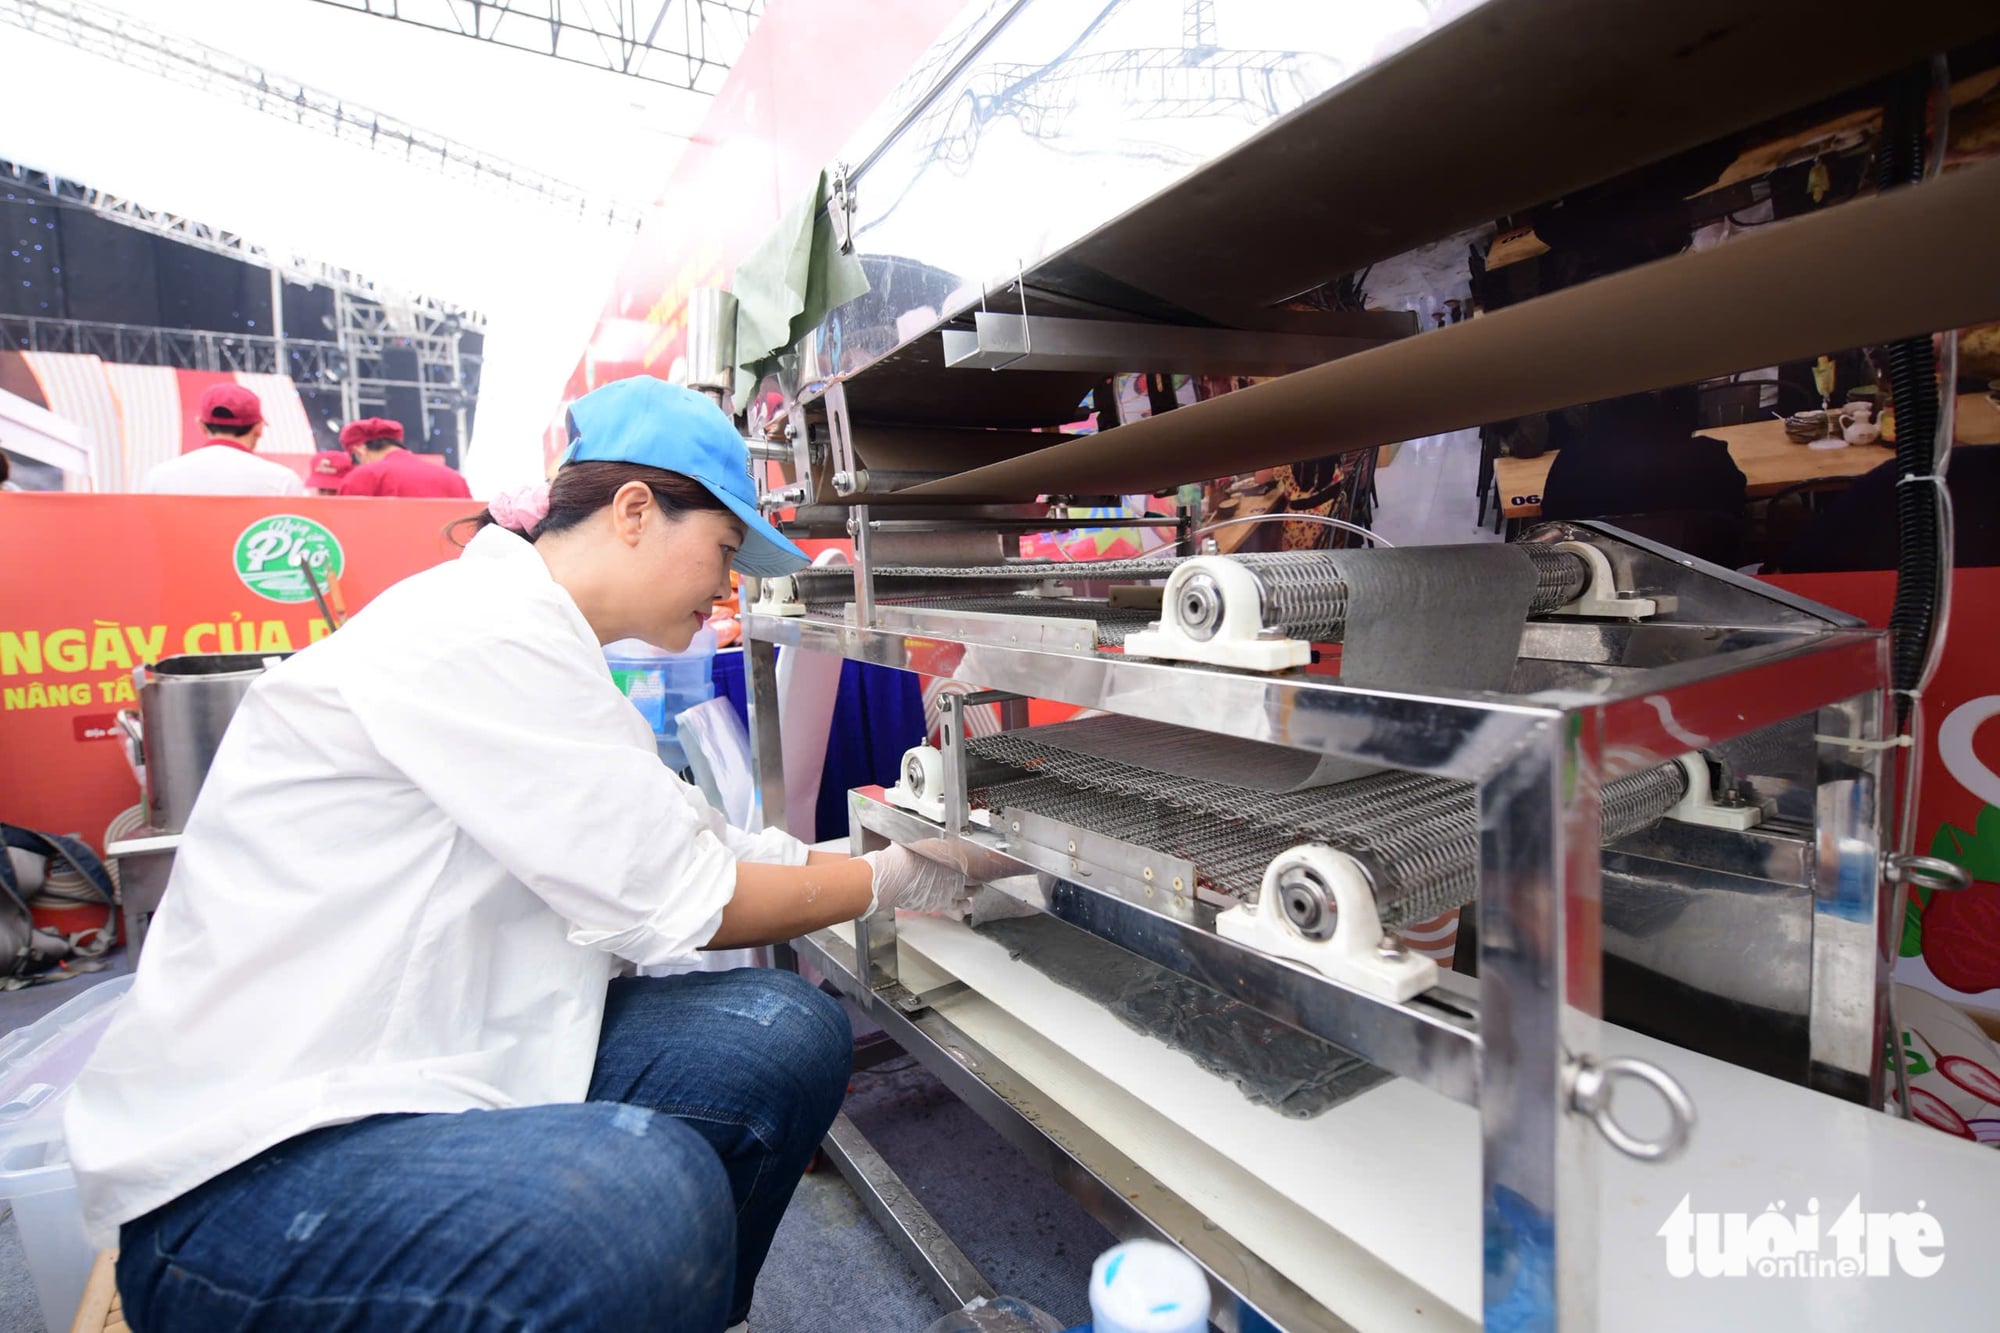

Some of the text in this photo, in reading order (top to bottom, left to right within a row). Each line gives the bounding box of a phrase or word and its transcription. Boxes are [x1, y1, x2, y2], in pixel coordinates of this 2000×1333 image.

[1511, 495, 1541, 506] 06
[0, 619, 168, 675] NGÀY
[183, 611, 293, 655] CỦA
[4, 681, 92, 710] NÂNG
